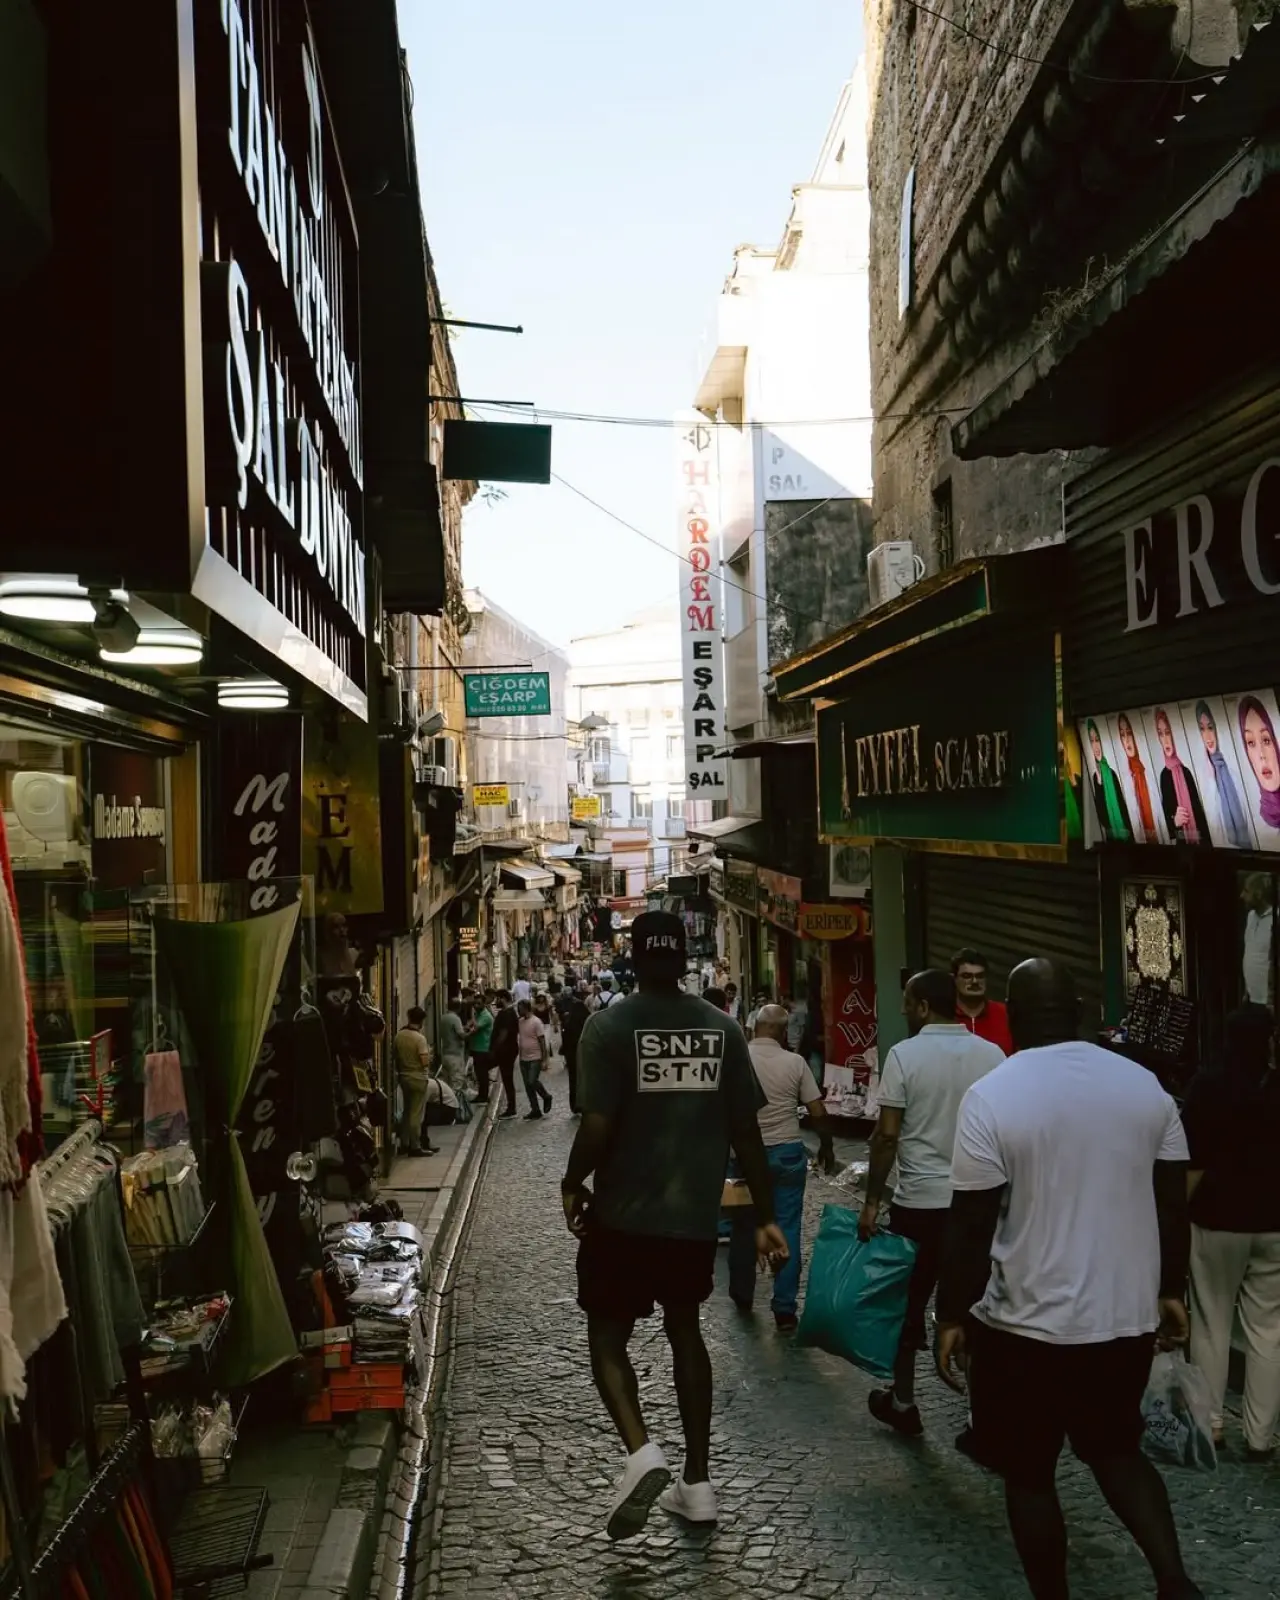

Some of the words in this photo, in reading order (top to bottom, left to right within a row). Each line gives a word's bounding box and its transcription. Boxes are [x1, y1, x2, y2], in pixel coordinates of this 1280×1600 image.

[226, 257, 295, 528] ŞAL
[682, 460, 718, 633] HARDEM
[468, 676, 546, 693] ÇİĞDEM
[479, 690, 537, 706] EŞARP
[691, 640, 717, 763] EŞARP
[689, 770, 725, 790] ŞAL
[854, 723, 929, 798] EYFEL
